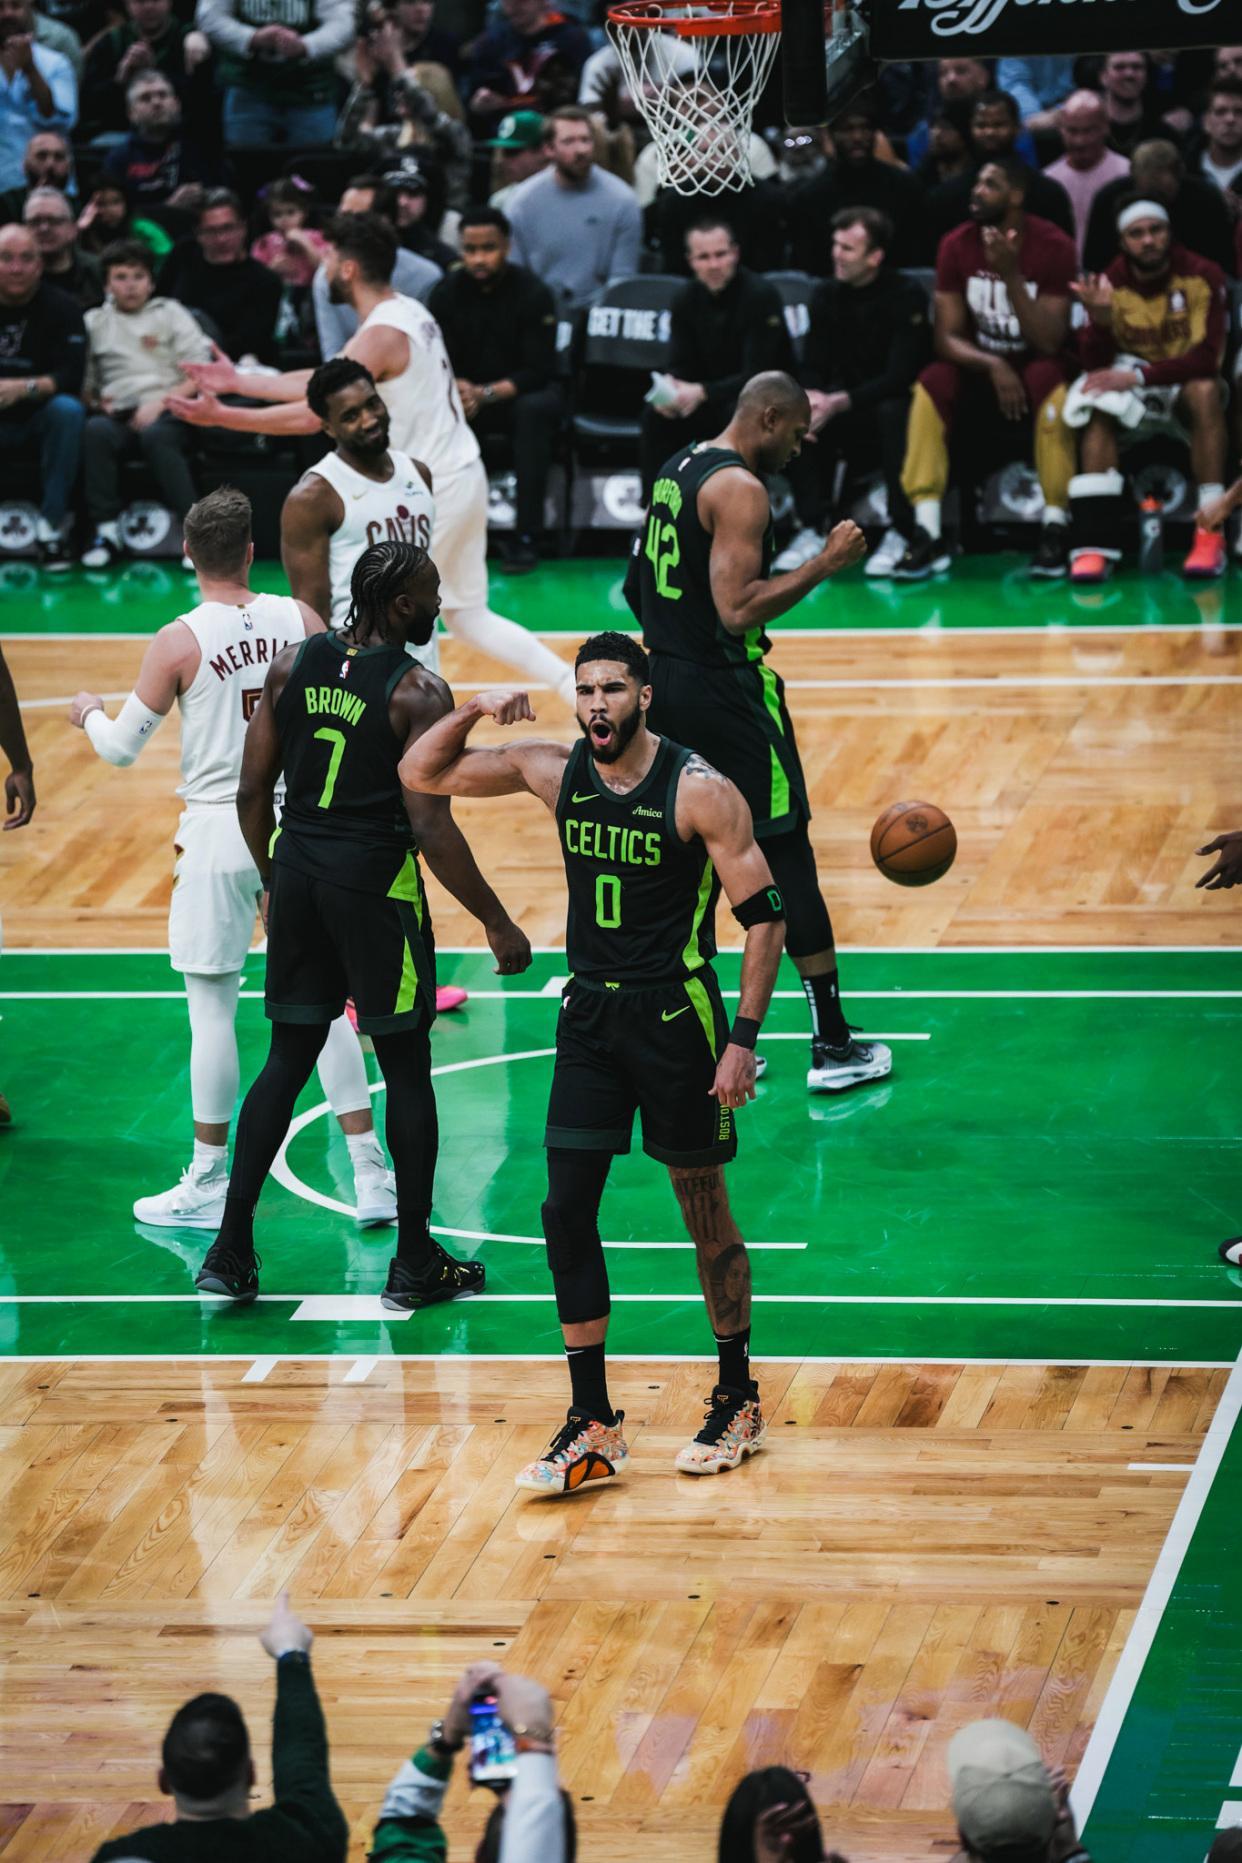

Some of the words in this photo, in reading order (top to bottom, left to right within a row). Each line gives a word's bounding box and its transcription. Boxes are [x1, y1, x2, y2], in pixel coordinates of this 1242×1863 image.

[645, 515, 683, 600] 42
[304, 686, 367, 727] BROWN
[313, 727, 346, 810] 7
[632, 805, 663, 818] Amica
[565, 818, 662, 866] CELTICS
[595, 874, 622, 929] 0
